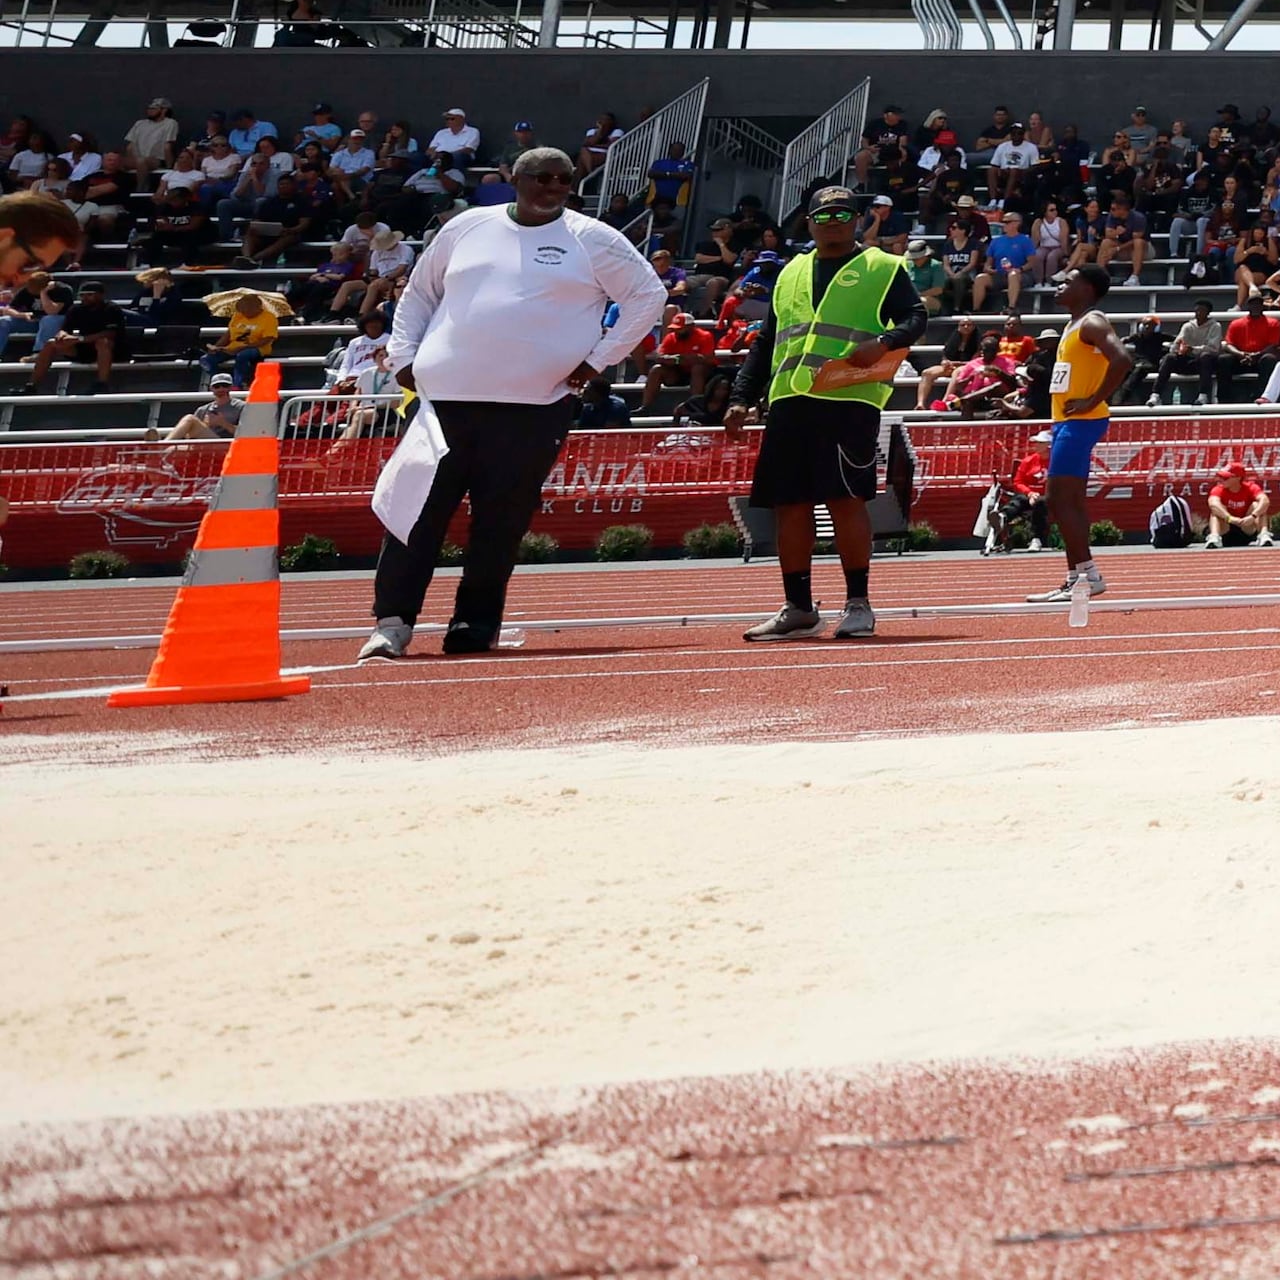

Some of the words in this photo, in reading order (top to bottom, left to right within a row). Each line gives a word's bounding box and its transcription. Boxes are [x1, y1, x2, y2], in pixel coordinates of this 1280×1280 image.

[1050, 370, 1068, 384] 27
[541, 461, 647, 497] ANTA
[1146, 482, 1209, 497] TRAC
[574, 498, 643, 514] CLUB
